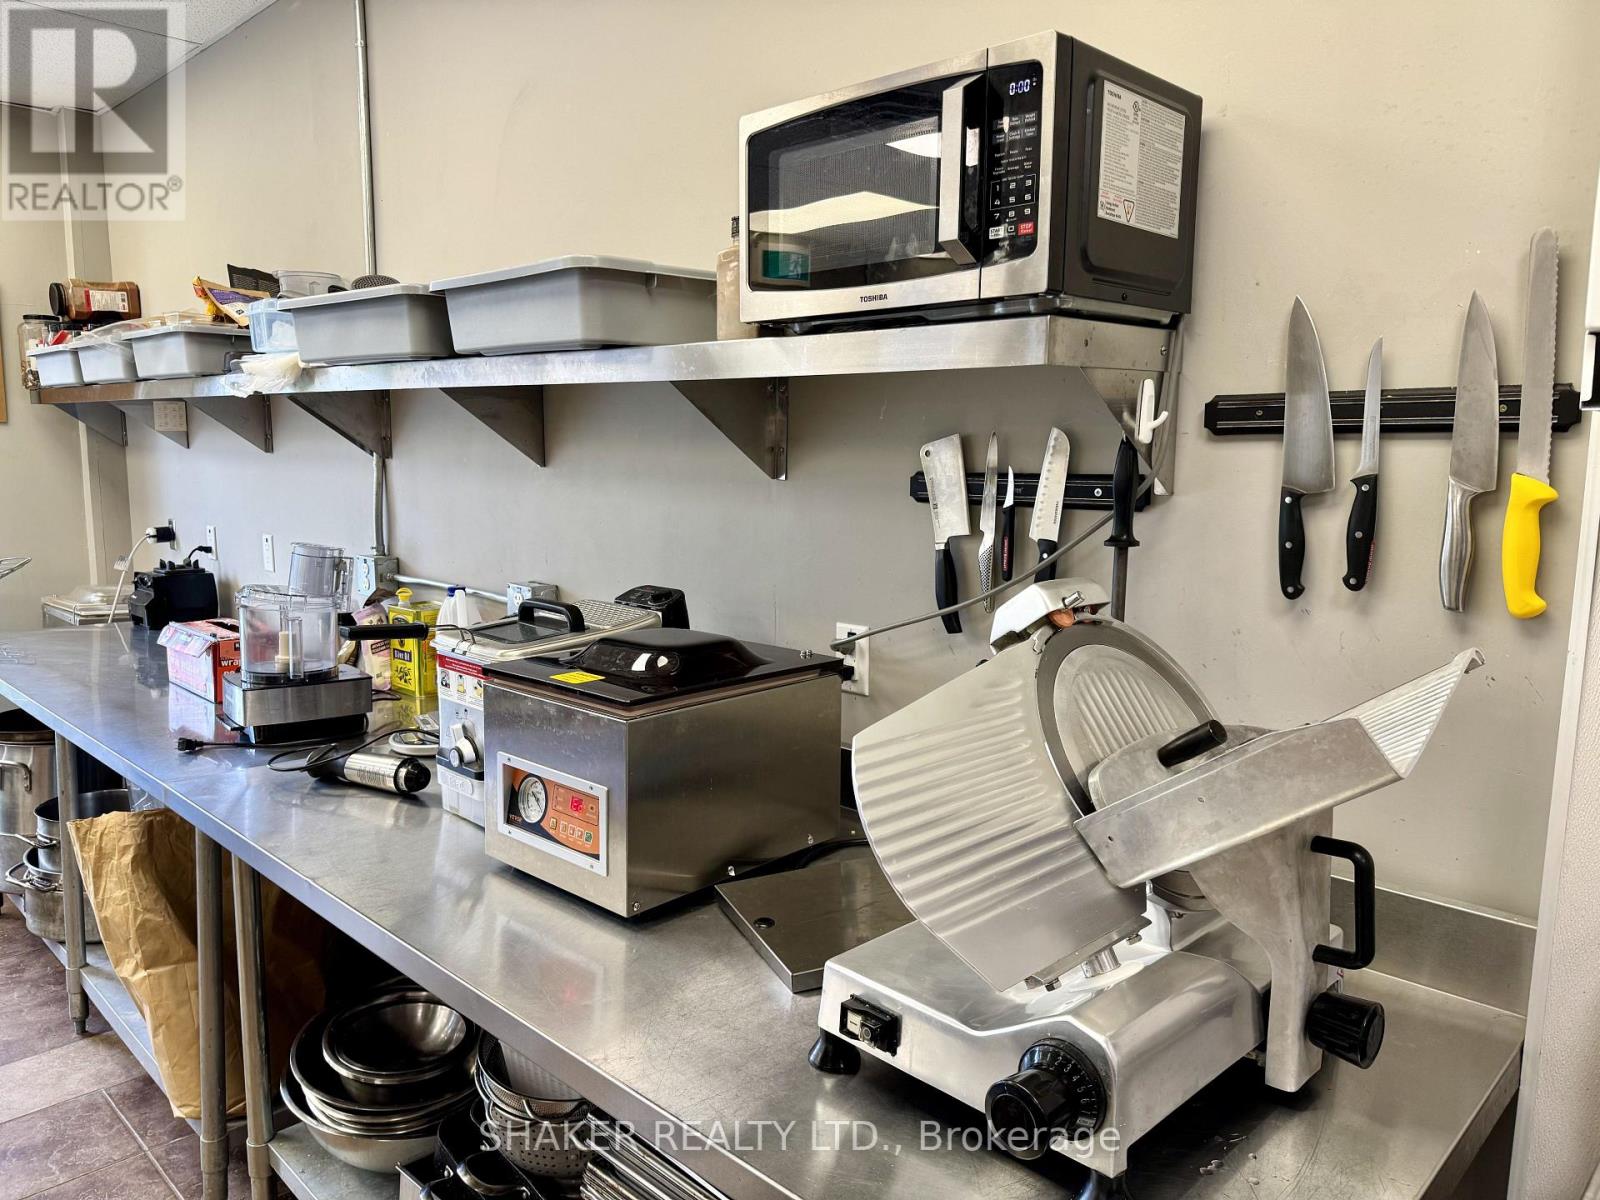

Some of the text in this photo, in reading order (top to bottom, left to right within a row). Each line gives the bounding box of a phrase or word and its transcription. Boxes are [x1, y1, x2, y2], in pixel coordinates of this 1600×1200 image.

[1009, 79, 1031, 96] 0:00
[859, 293, 888, 303] TOSHIBA
[221, 659, 241, 668] wra
